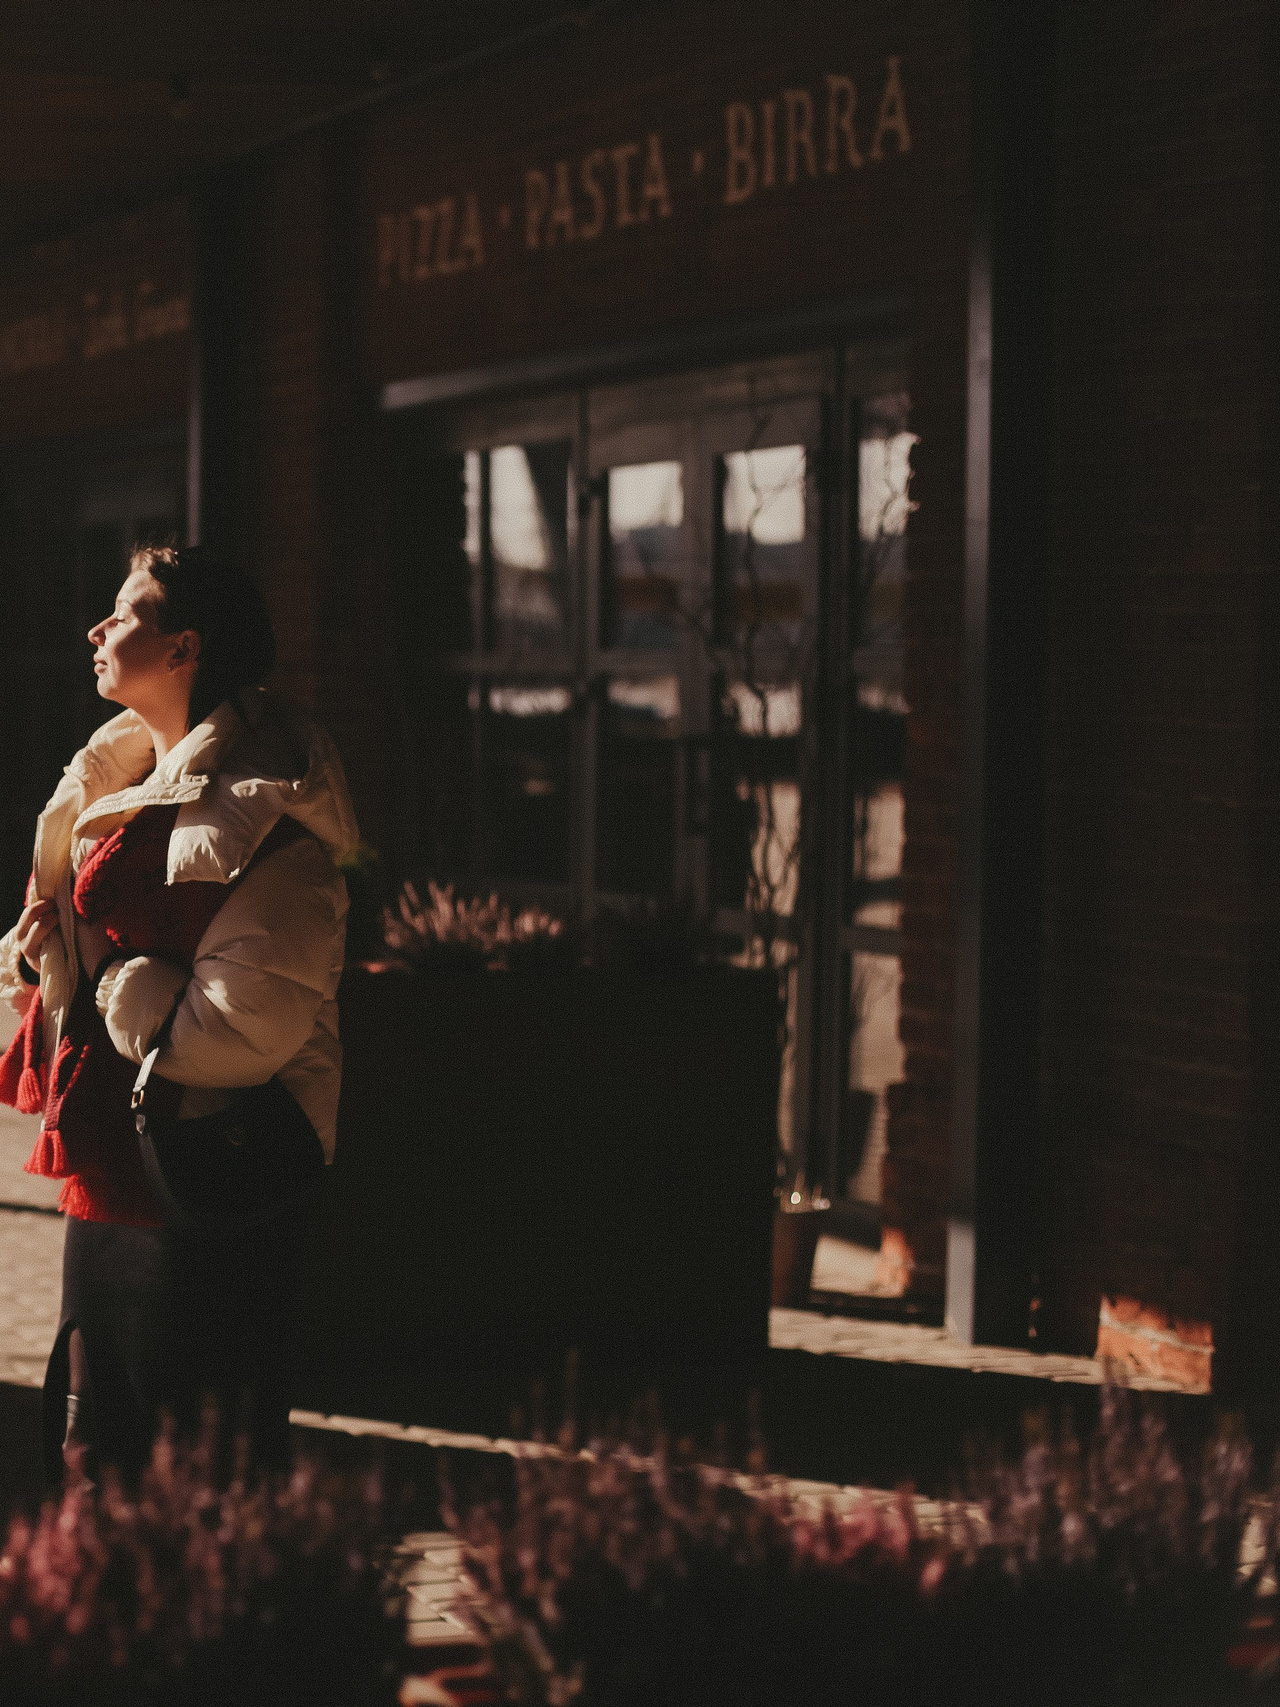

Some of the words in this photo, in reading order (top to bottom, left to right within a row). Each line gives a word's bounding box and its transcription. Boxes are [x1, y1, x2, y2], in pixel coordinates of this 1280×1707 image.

[377, 192, 486, 289] PIZZA
[524, 132, 674, 251] PASTA
[723, 55, 913, 205] BIRRA
